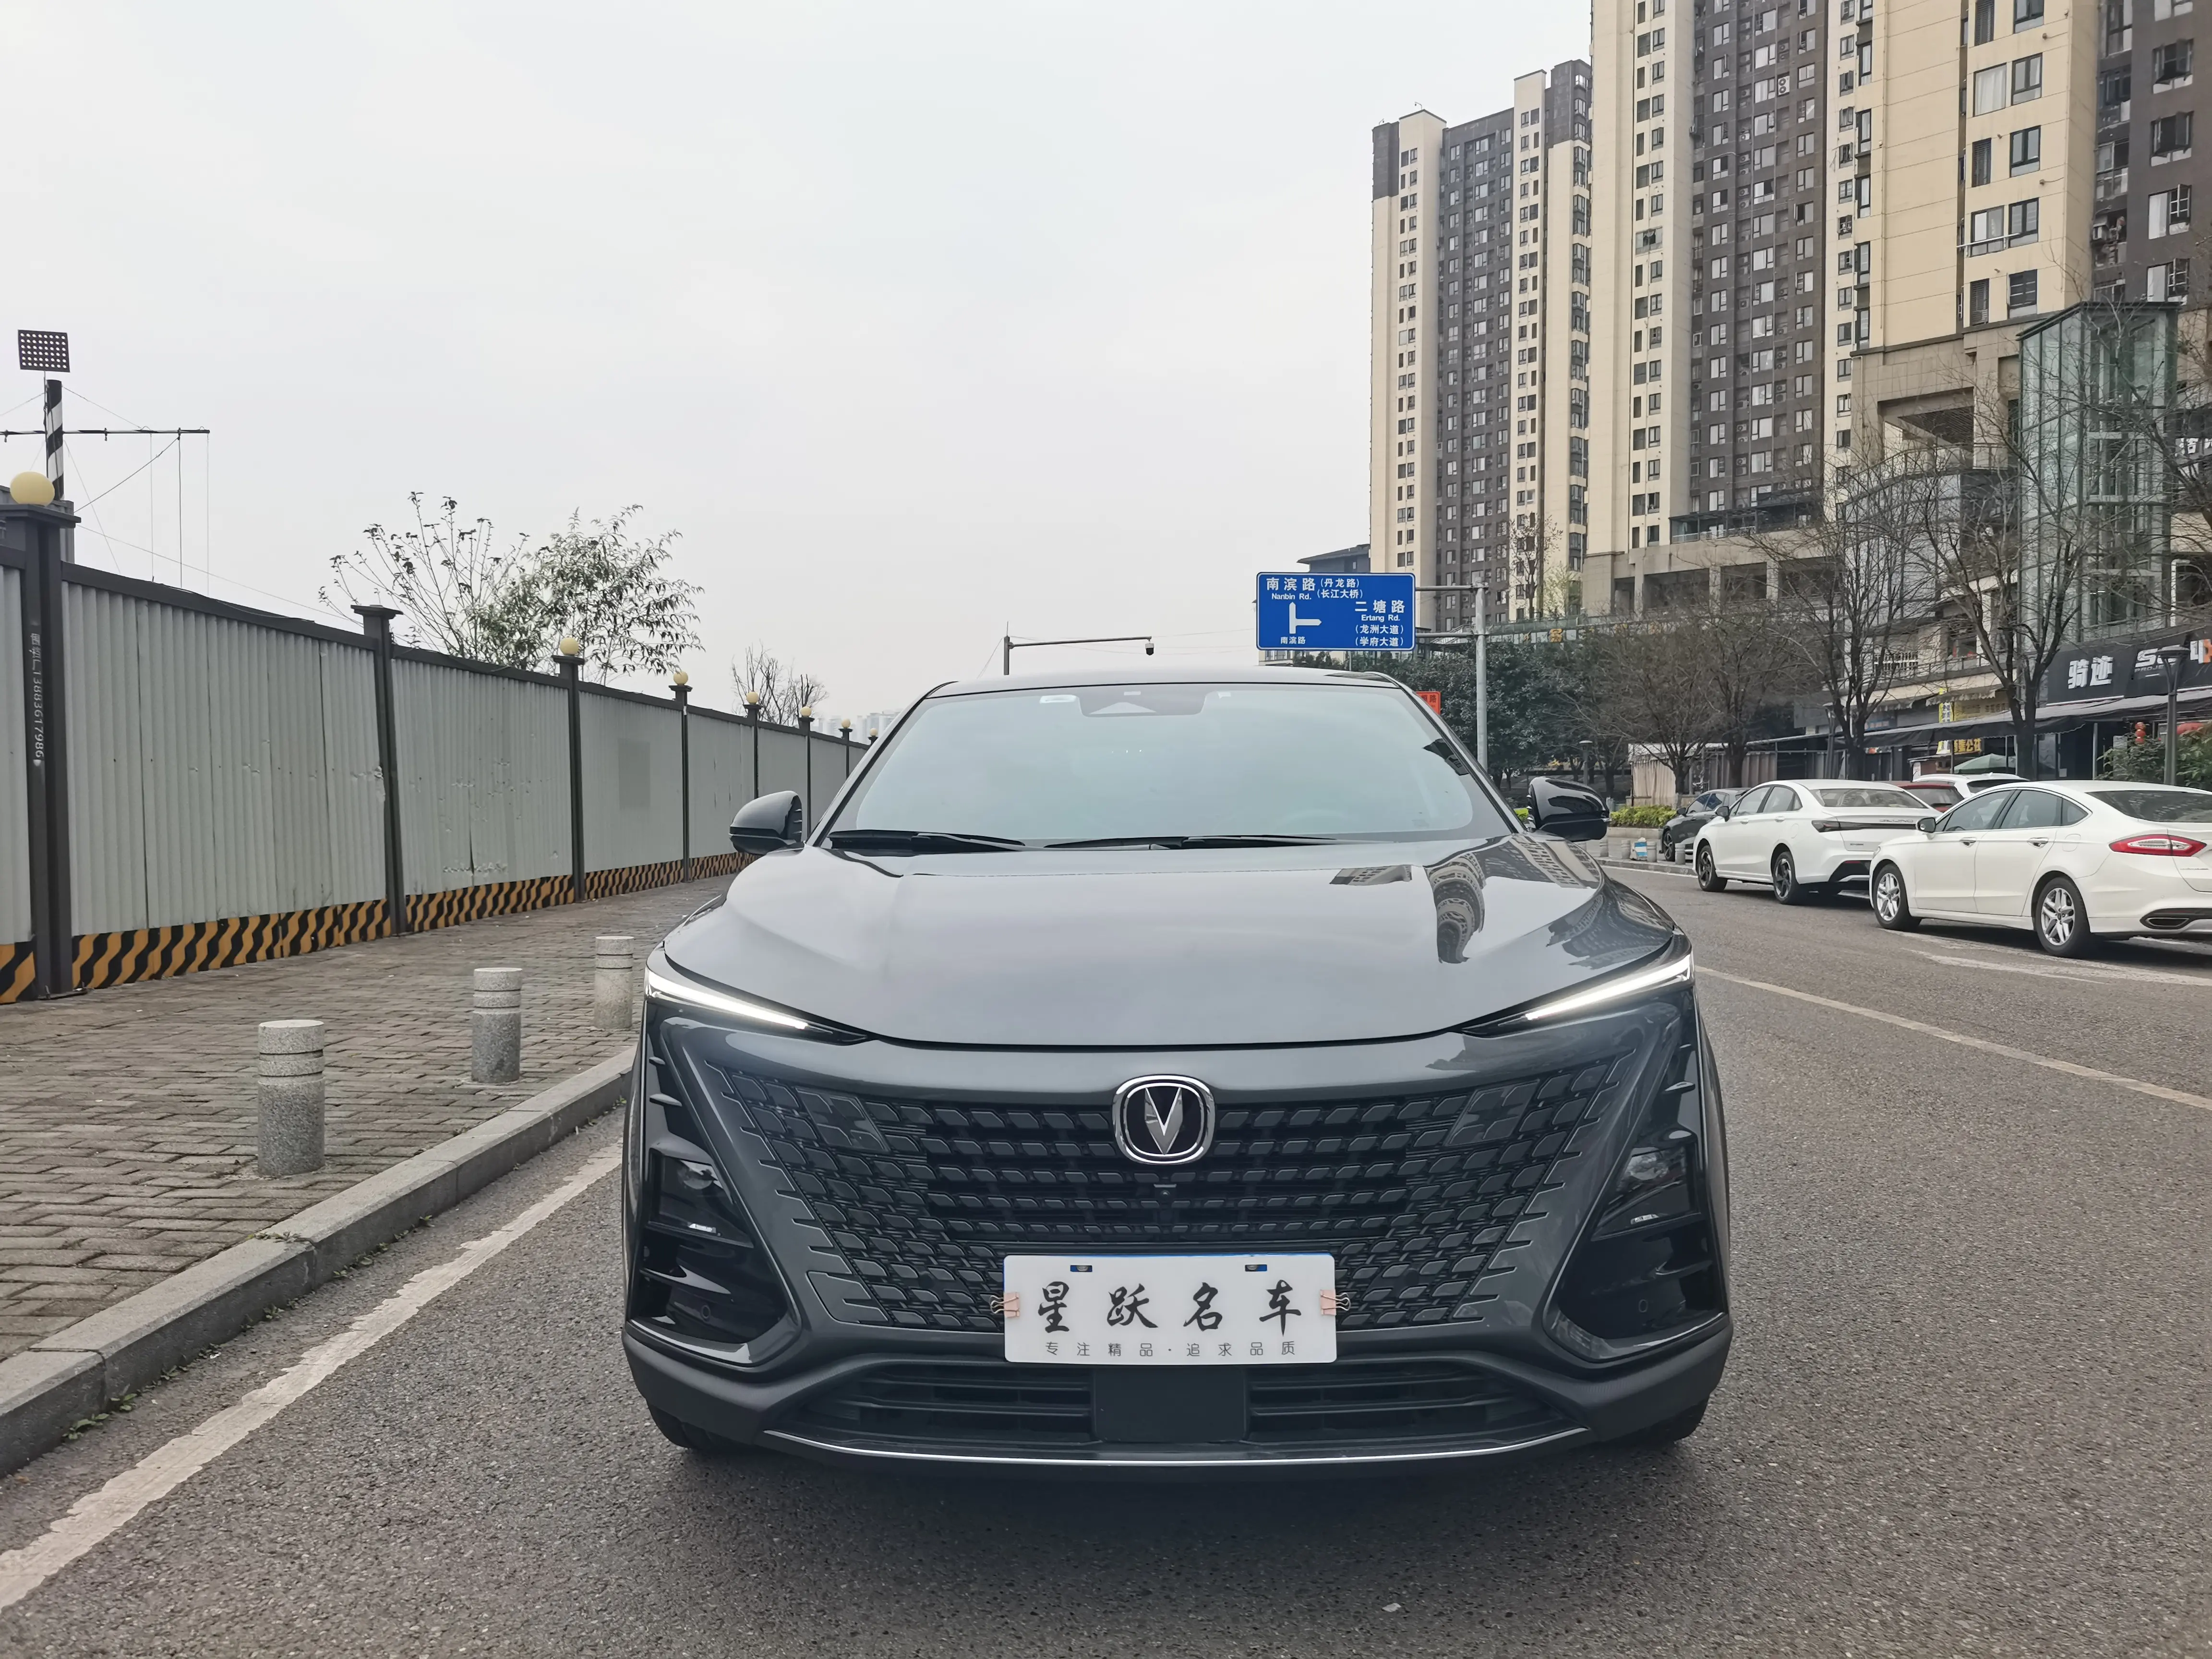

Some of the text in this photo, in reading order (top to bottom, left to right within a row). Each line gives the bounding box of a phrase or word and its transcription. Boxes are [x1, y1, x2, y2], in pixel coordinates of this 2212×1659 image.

[1266, 577, 1316, 591] 南滨路
[1354, 599, 1405, 613] 二塘路
[1360, 614, 1384, 623] Ertang
[1280, 636, 1306, 644] 南滨路
[33, 671, 45, 757] 13883617986
[1037, 1279, 1302, 1336] 星跃名车
